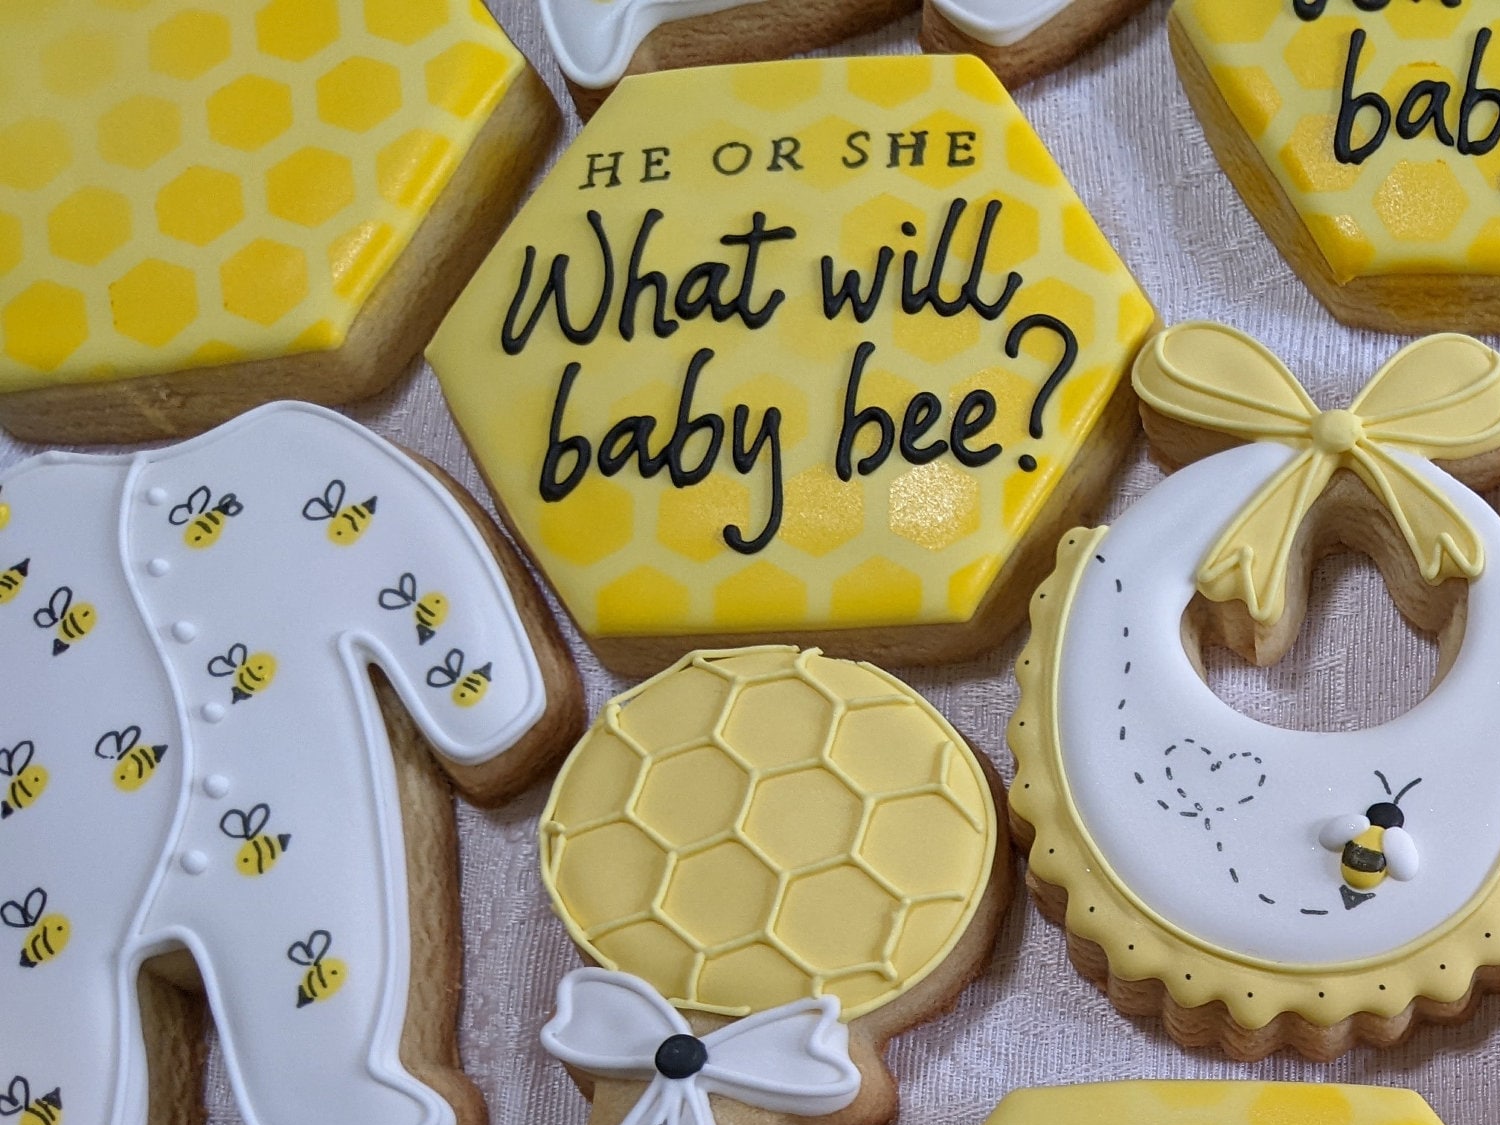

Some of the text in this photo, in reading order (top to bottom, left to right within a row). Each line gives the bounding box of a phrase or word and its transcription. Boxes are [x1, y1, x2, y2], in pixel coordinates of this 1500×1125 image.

[578, 130, 977, 191] HE OR SHE
[500, 197, 1023, 356] What will
[538, 313, 1079, 556] baby bee?
